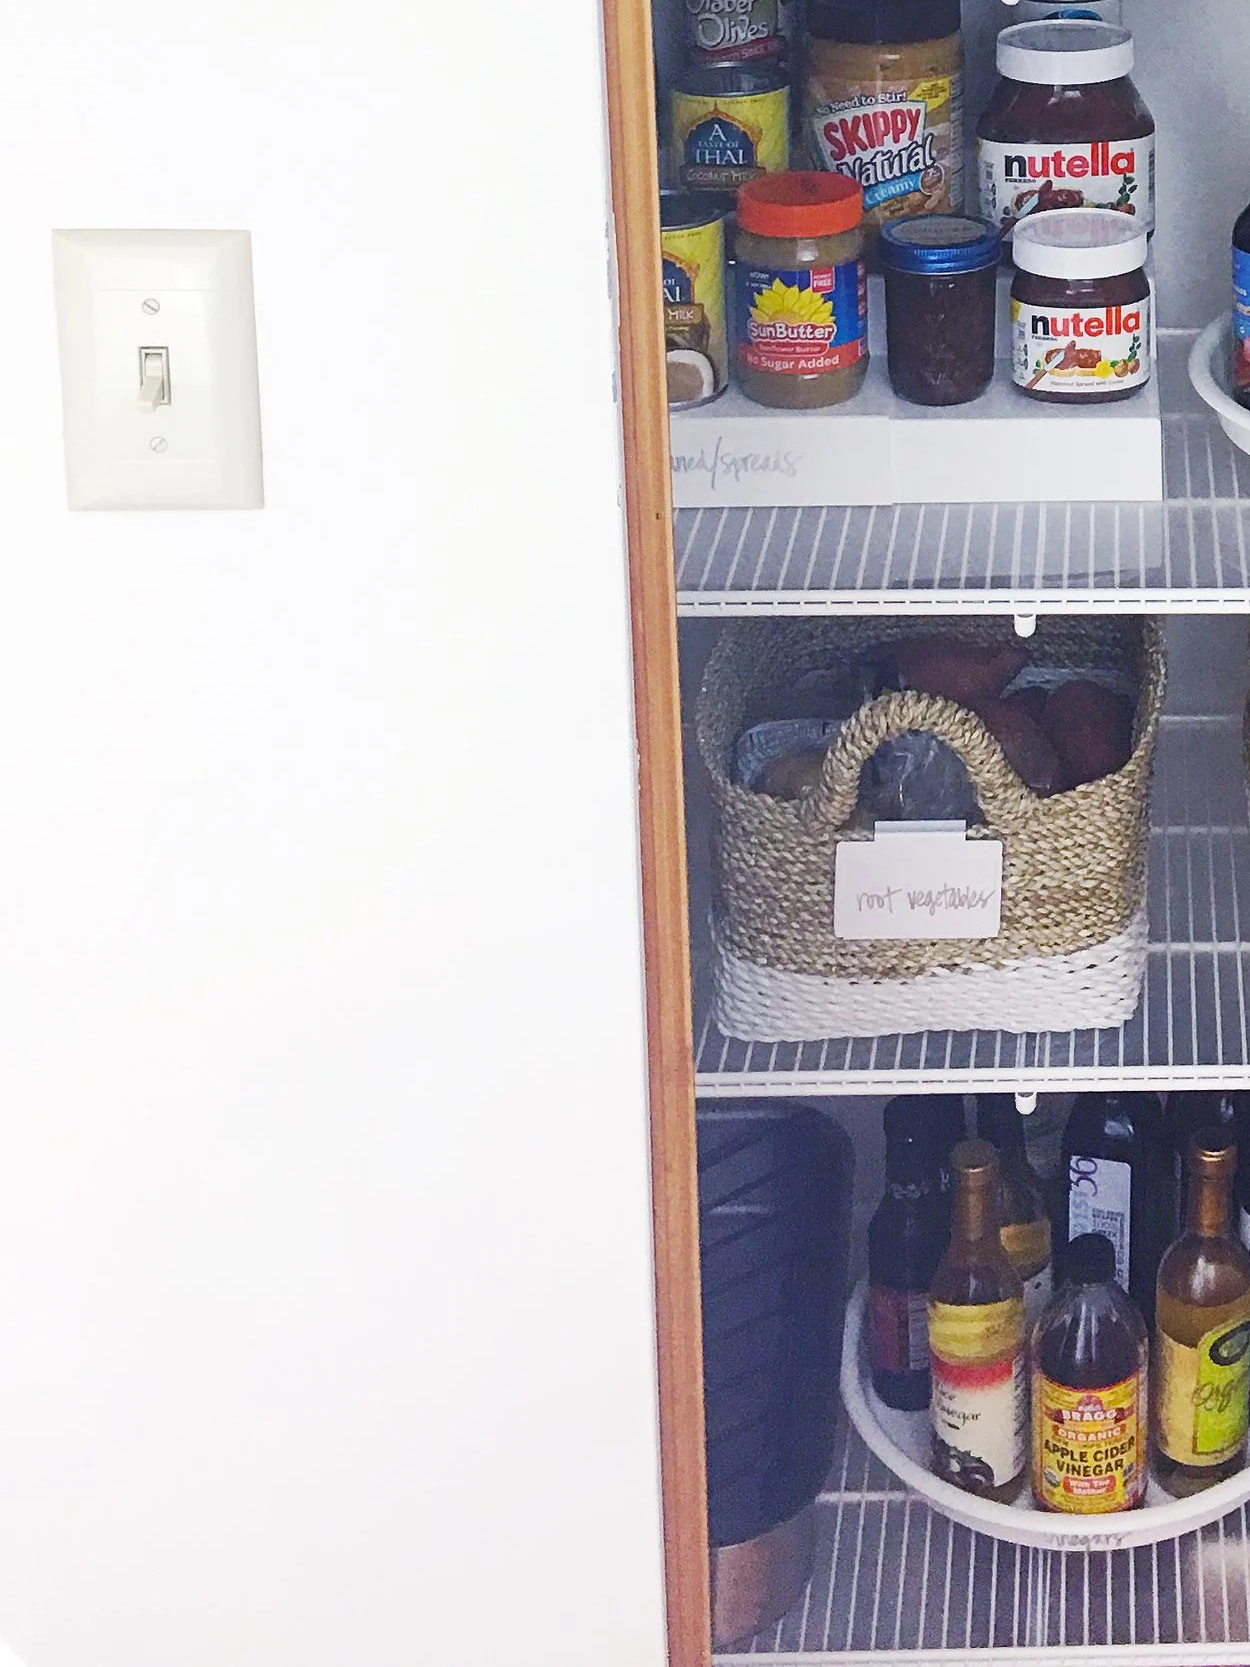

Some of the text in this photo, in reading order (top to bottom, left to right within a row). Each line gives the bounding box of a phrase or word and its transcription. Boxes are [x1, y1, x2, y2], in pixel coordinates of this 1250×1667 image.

[697, 13, 769, 48] Olives
[830, 96, 861, 111] Need
[861, 95, 876, 105] to
[877, 91, 907, 103] Stir!
[708, 123, 727, 142] A
[823, 108, 922, 162] SKIPPY
[695, 149, 749, 166] THAI
[836, 132, 935, 187] Natural
[1004, 142, 1136, 179] nutella
[865, 177, 917, 206] Creamy
[667, 309, 695, 320] MILK
[1031, 305, 1141, 337] nutella
[750, 321, 833, 340] SunButter
[761, 356, 795, 372] Sugar
[798, 354, 839, 369] Added
[856, 882, 996, 917] root vegetables
[1061, 1408, 1118, 1421] BRAGG
[1057, 1426, 1121, 1442] ORGANIC
[1044, 1435, 1135, 1464] APPLE CIDER
[1056, 1458, 1124, 1478] VINEGAR
